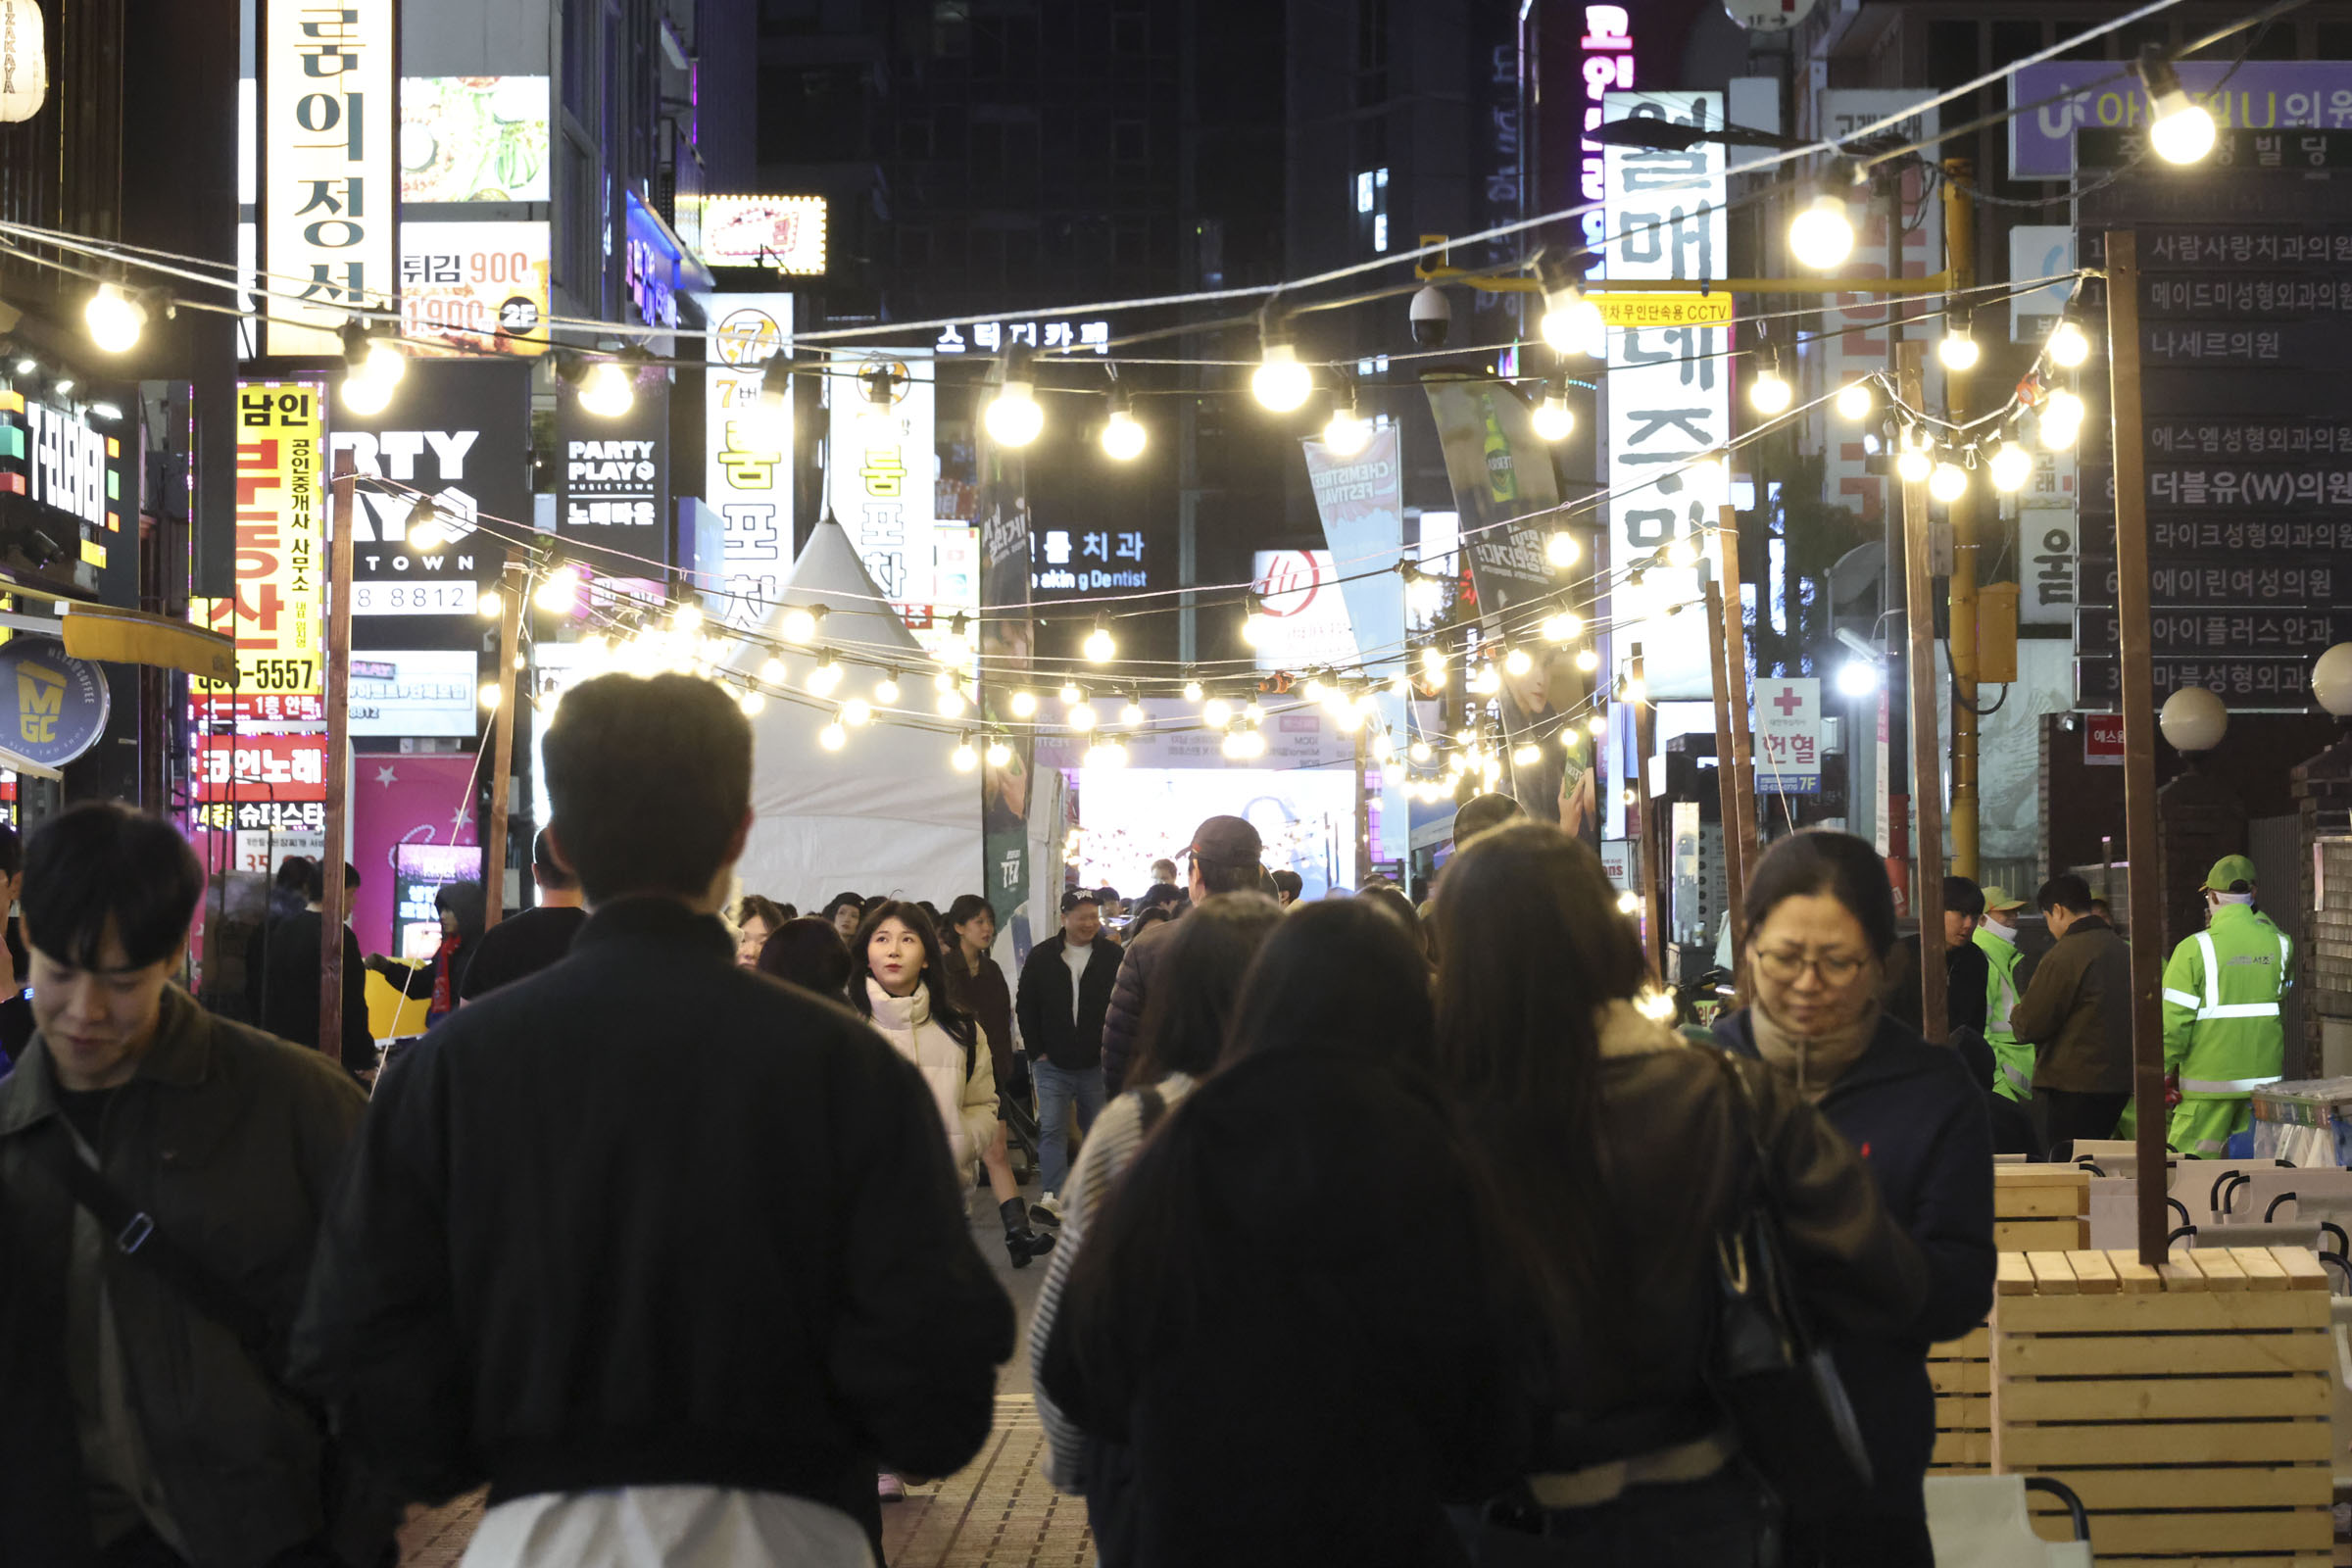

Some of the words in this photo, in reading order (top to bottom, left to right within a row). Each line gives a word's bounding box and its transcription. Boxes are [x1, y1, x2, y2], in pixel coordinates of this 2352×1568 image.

[403, 255, 461, 283] 튀김
[470, 252, 527, 283] 900
[503, 303, 537, 328] 2F
[1687, 305, 1727, 320] CCTV
[2152, 331, 2279, 360] 나세르의원
[567, 441, 656, 460] PARTY
[291, 438, 311, 530] 공인중개사
[567, 502, 656, 525] 노래타운
[291, 539, 311, 592] 사무소
[365, 555, 474, 571] TOWN
[1090, 568, 1148, 589] Dentist
[2151, 568, 2331, 597] 에이린여성의원
[390, 587, 465, 608] 8812
[2106, 619, 2120, 642] 5
[2153, 616, 2334, 646] 아이플러스안과
[2108, 666, 2120, 690] 3
[255, 696, 279, 715] 1층
[1761, 733, 1815, 764] 헌혈
[1799, 776, 1818, 791] 7F
[238, 802, 326, 827] 슈퍼스타
